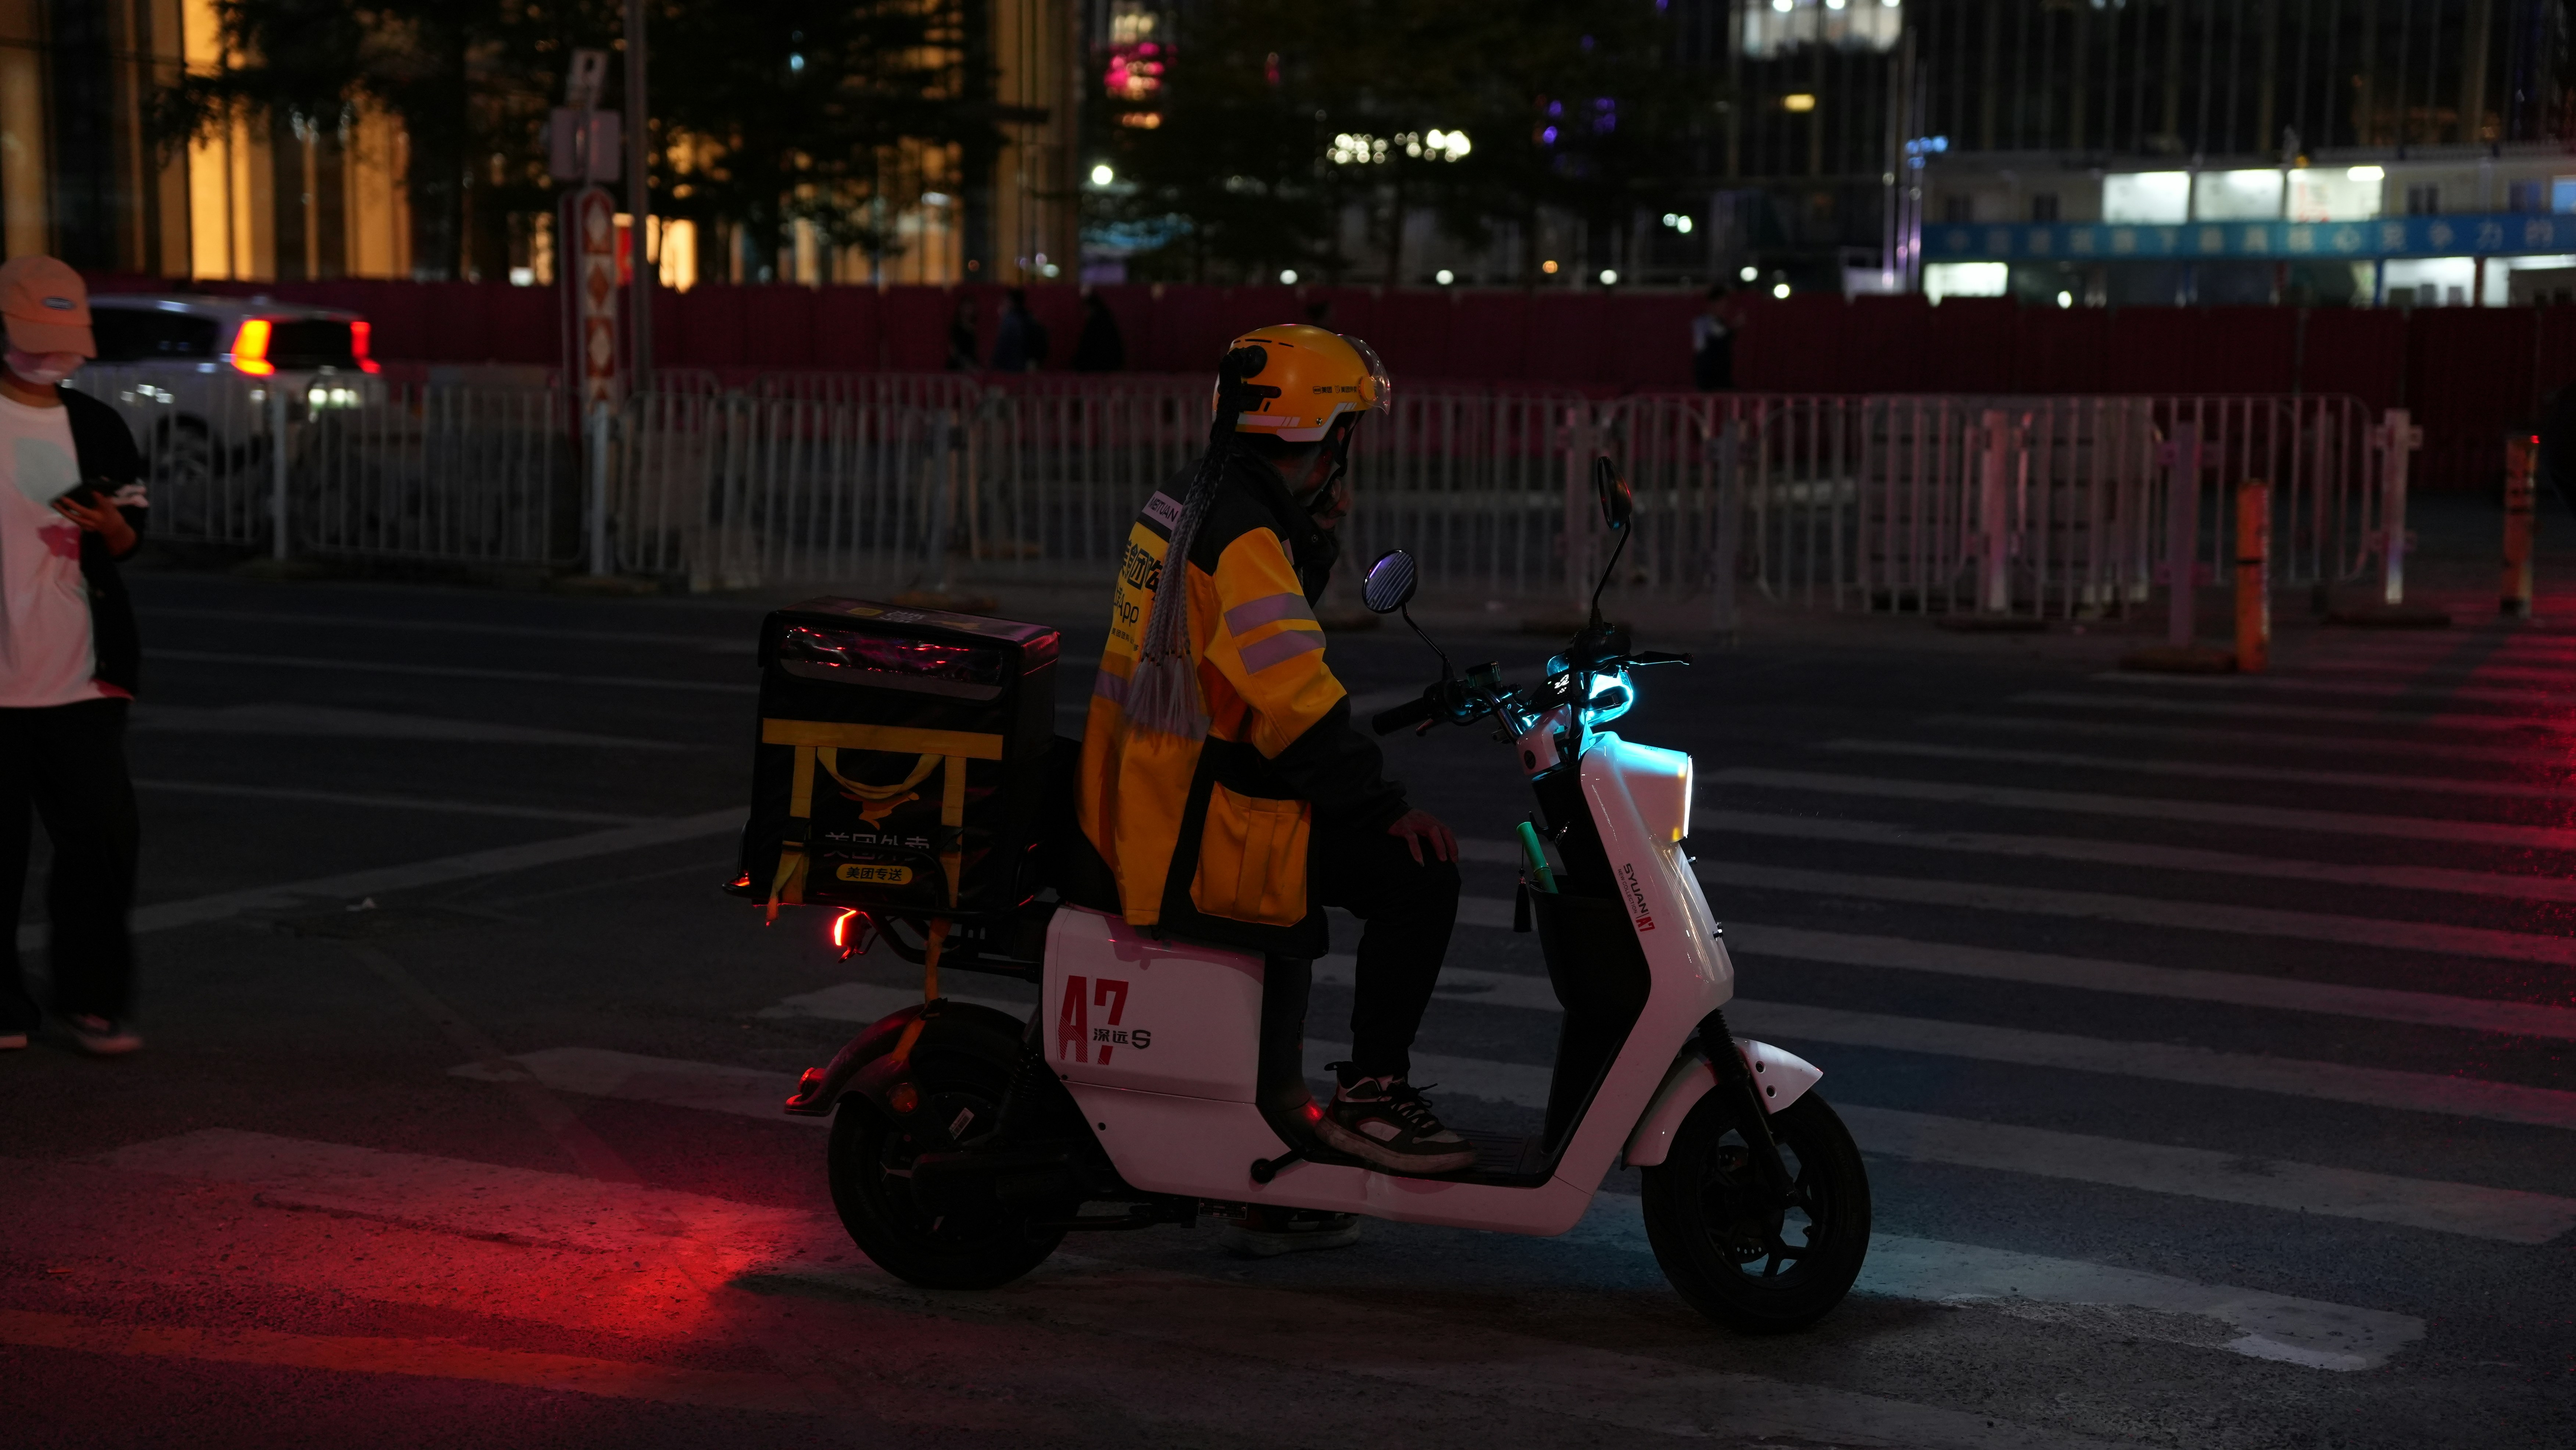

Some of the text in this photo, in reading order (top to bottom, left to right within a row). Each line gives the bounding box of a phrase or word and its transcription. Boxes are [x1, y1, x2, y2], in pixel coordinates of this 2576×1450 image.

[1148, 496, 1178, 522] MEITUAN
[846, 867, 902, 882] 美团专送
[1622, 881, 1637, 914] COLLECTION
[1623, 863, 1655, 932] SYUAN A7
[1058, 975, 1128, 1065] A7
